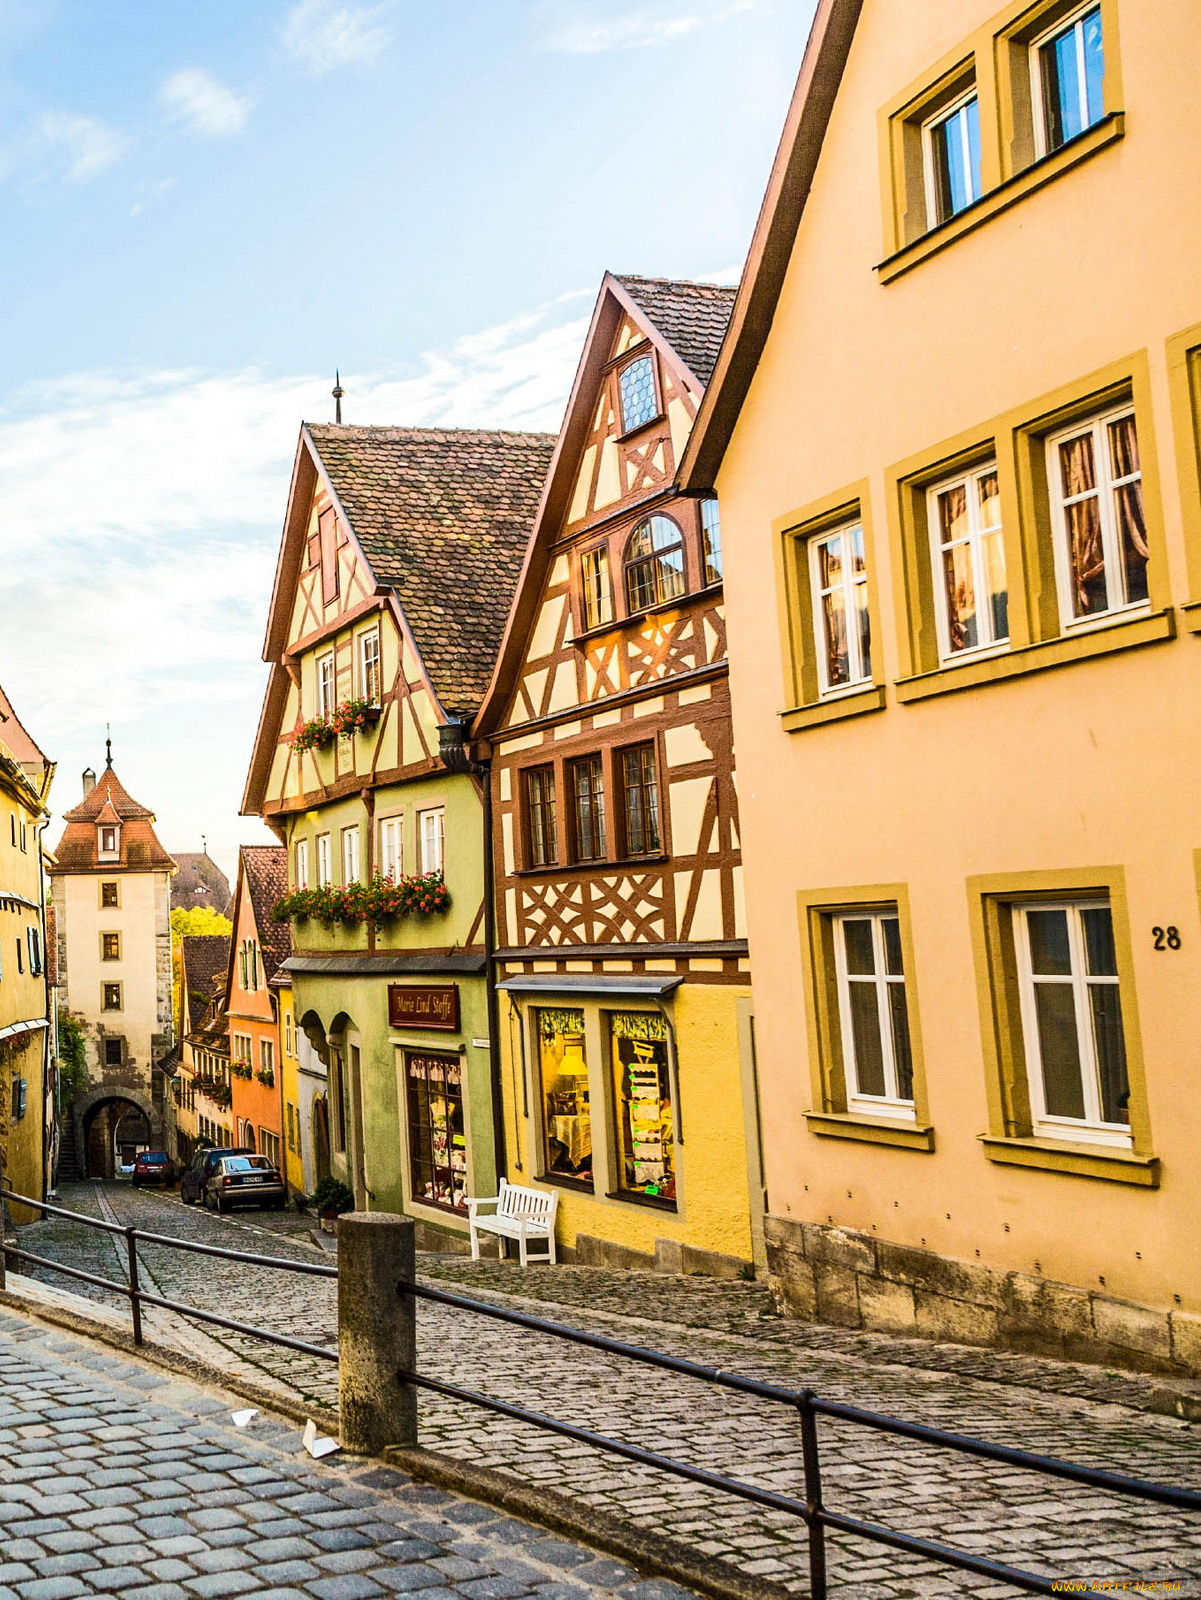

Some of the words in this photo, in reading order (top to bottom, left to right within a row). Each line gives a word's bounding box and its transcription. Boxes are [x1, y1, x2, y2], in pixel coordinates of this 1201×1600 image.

[1151, 925, 1182, 951] 28
[397, 996, 415, 1012] Marie
[416, 994, 430, 1013] Lind
[433, 994, 451, 1020] Stoffe
